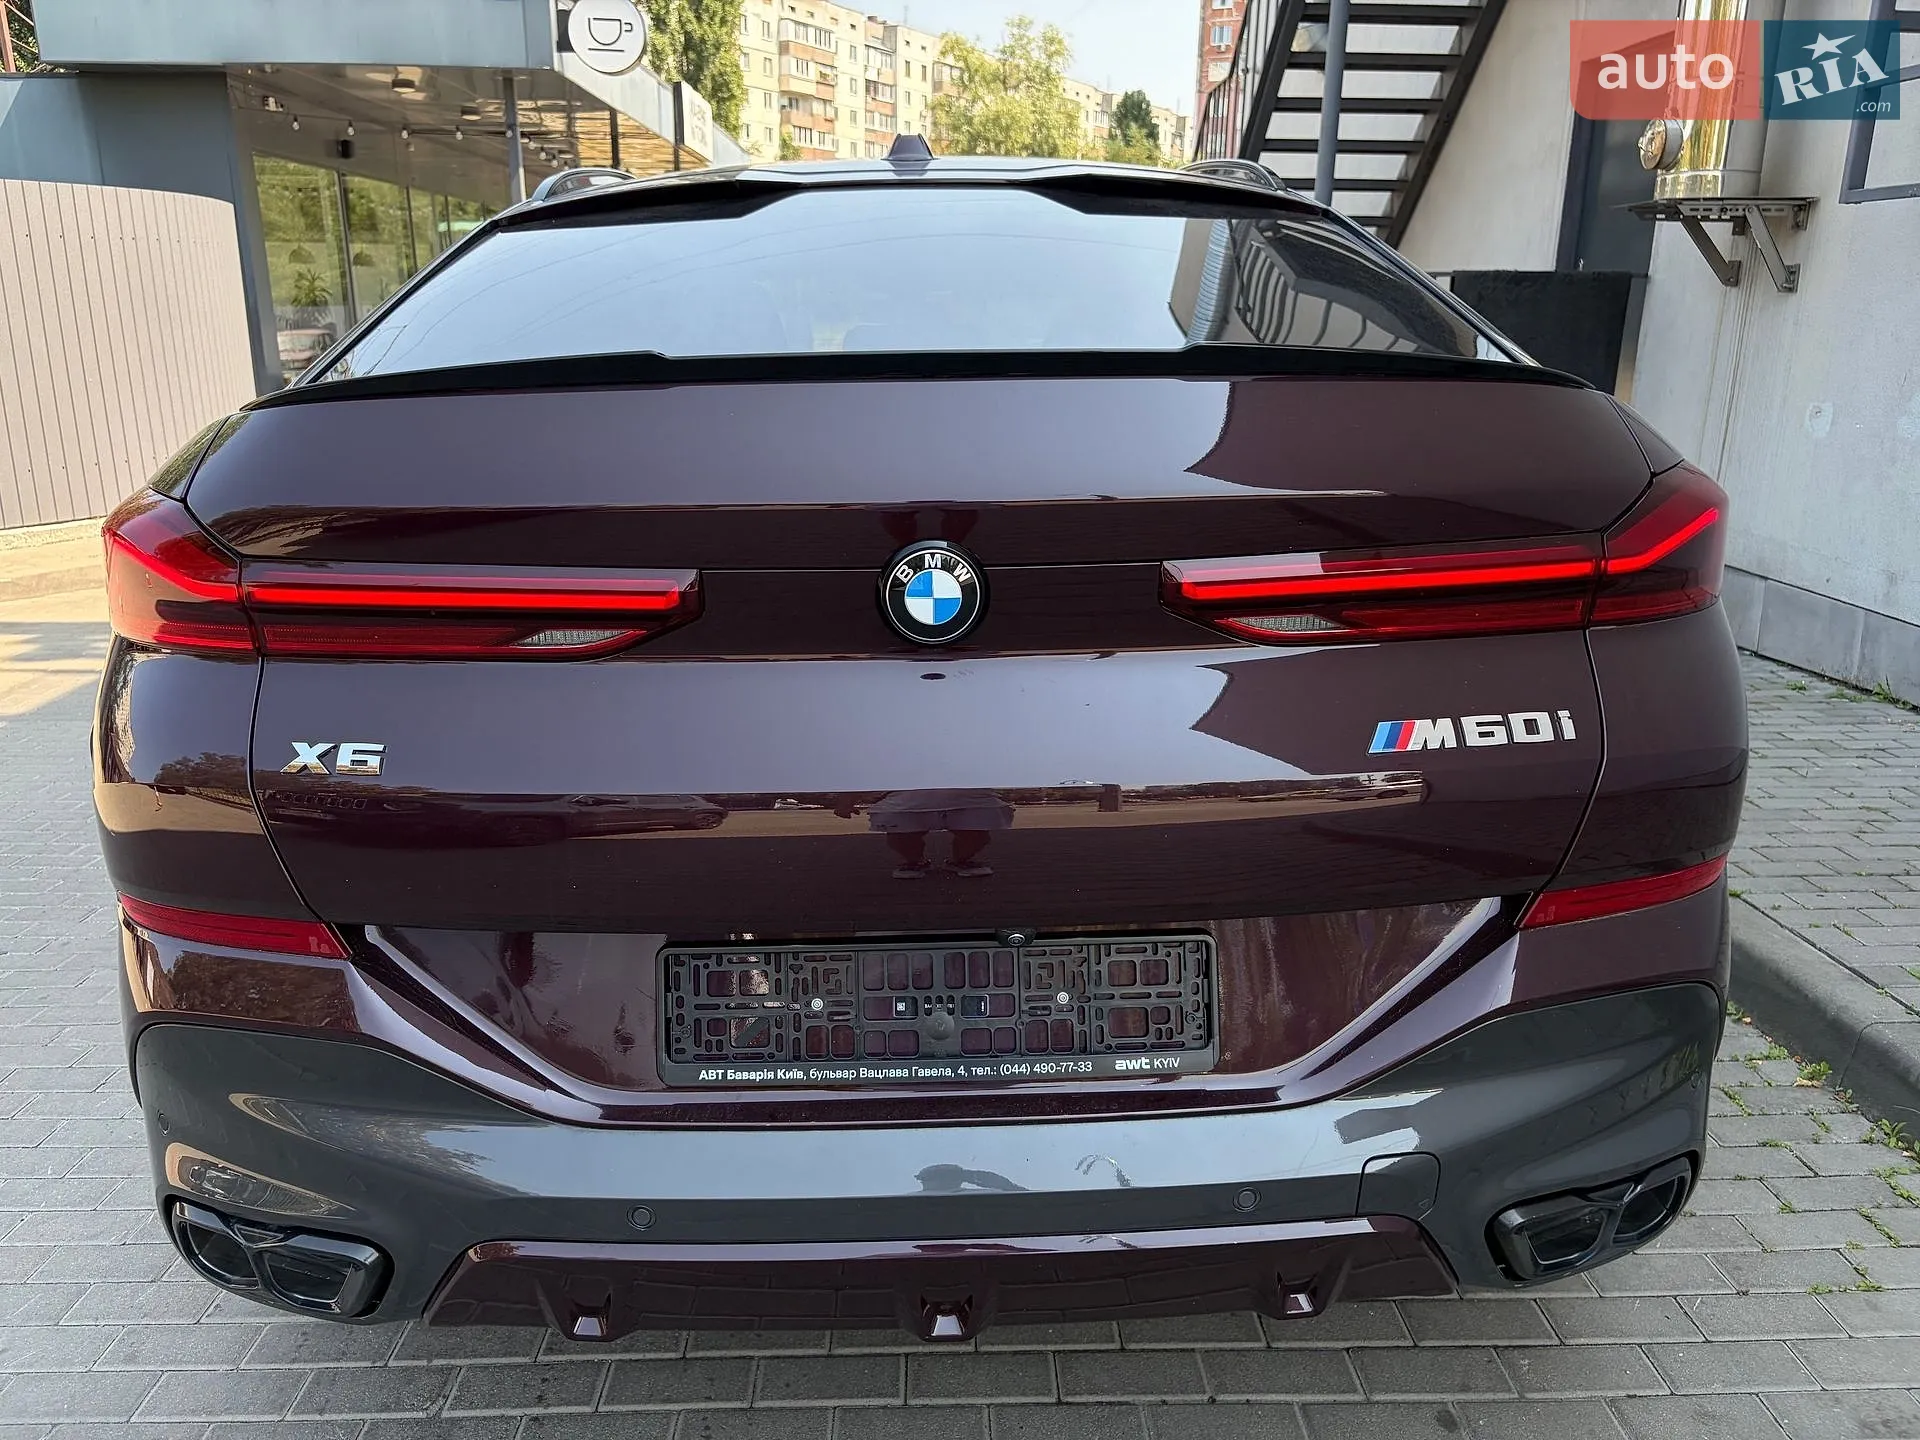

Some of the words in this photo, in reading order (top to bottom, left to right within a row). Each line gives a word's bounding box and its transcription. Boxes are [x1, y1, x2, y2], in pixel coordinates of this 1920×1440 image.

[895, 553, 971, 584] BMW
[1402, 709, 1577, 752] M60i
[280, 741, 387, 776] X6
[726, 1068, 775, 1082] Баварія
[777, 1067, 808, 1081] Київ,
[809, 1067, 857, 1082] бульвар
[859, 1067, 910, 1080] Вацлава
[912, 1065, 956, 1079] Гавела,
[957, 1064, 969, 1078] 4,
[970, 1065, 998, 1077] тел.:
[999, 1062, 1031, 1076] (044)
[1032, 1061, 1093, 1075] 490-77-33
[1114, 1056, 1151, 1071] awt
[1153, 1056, 1181, 1070] KYIV
